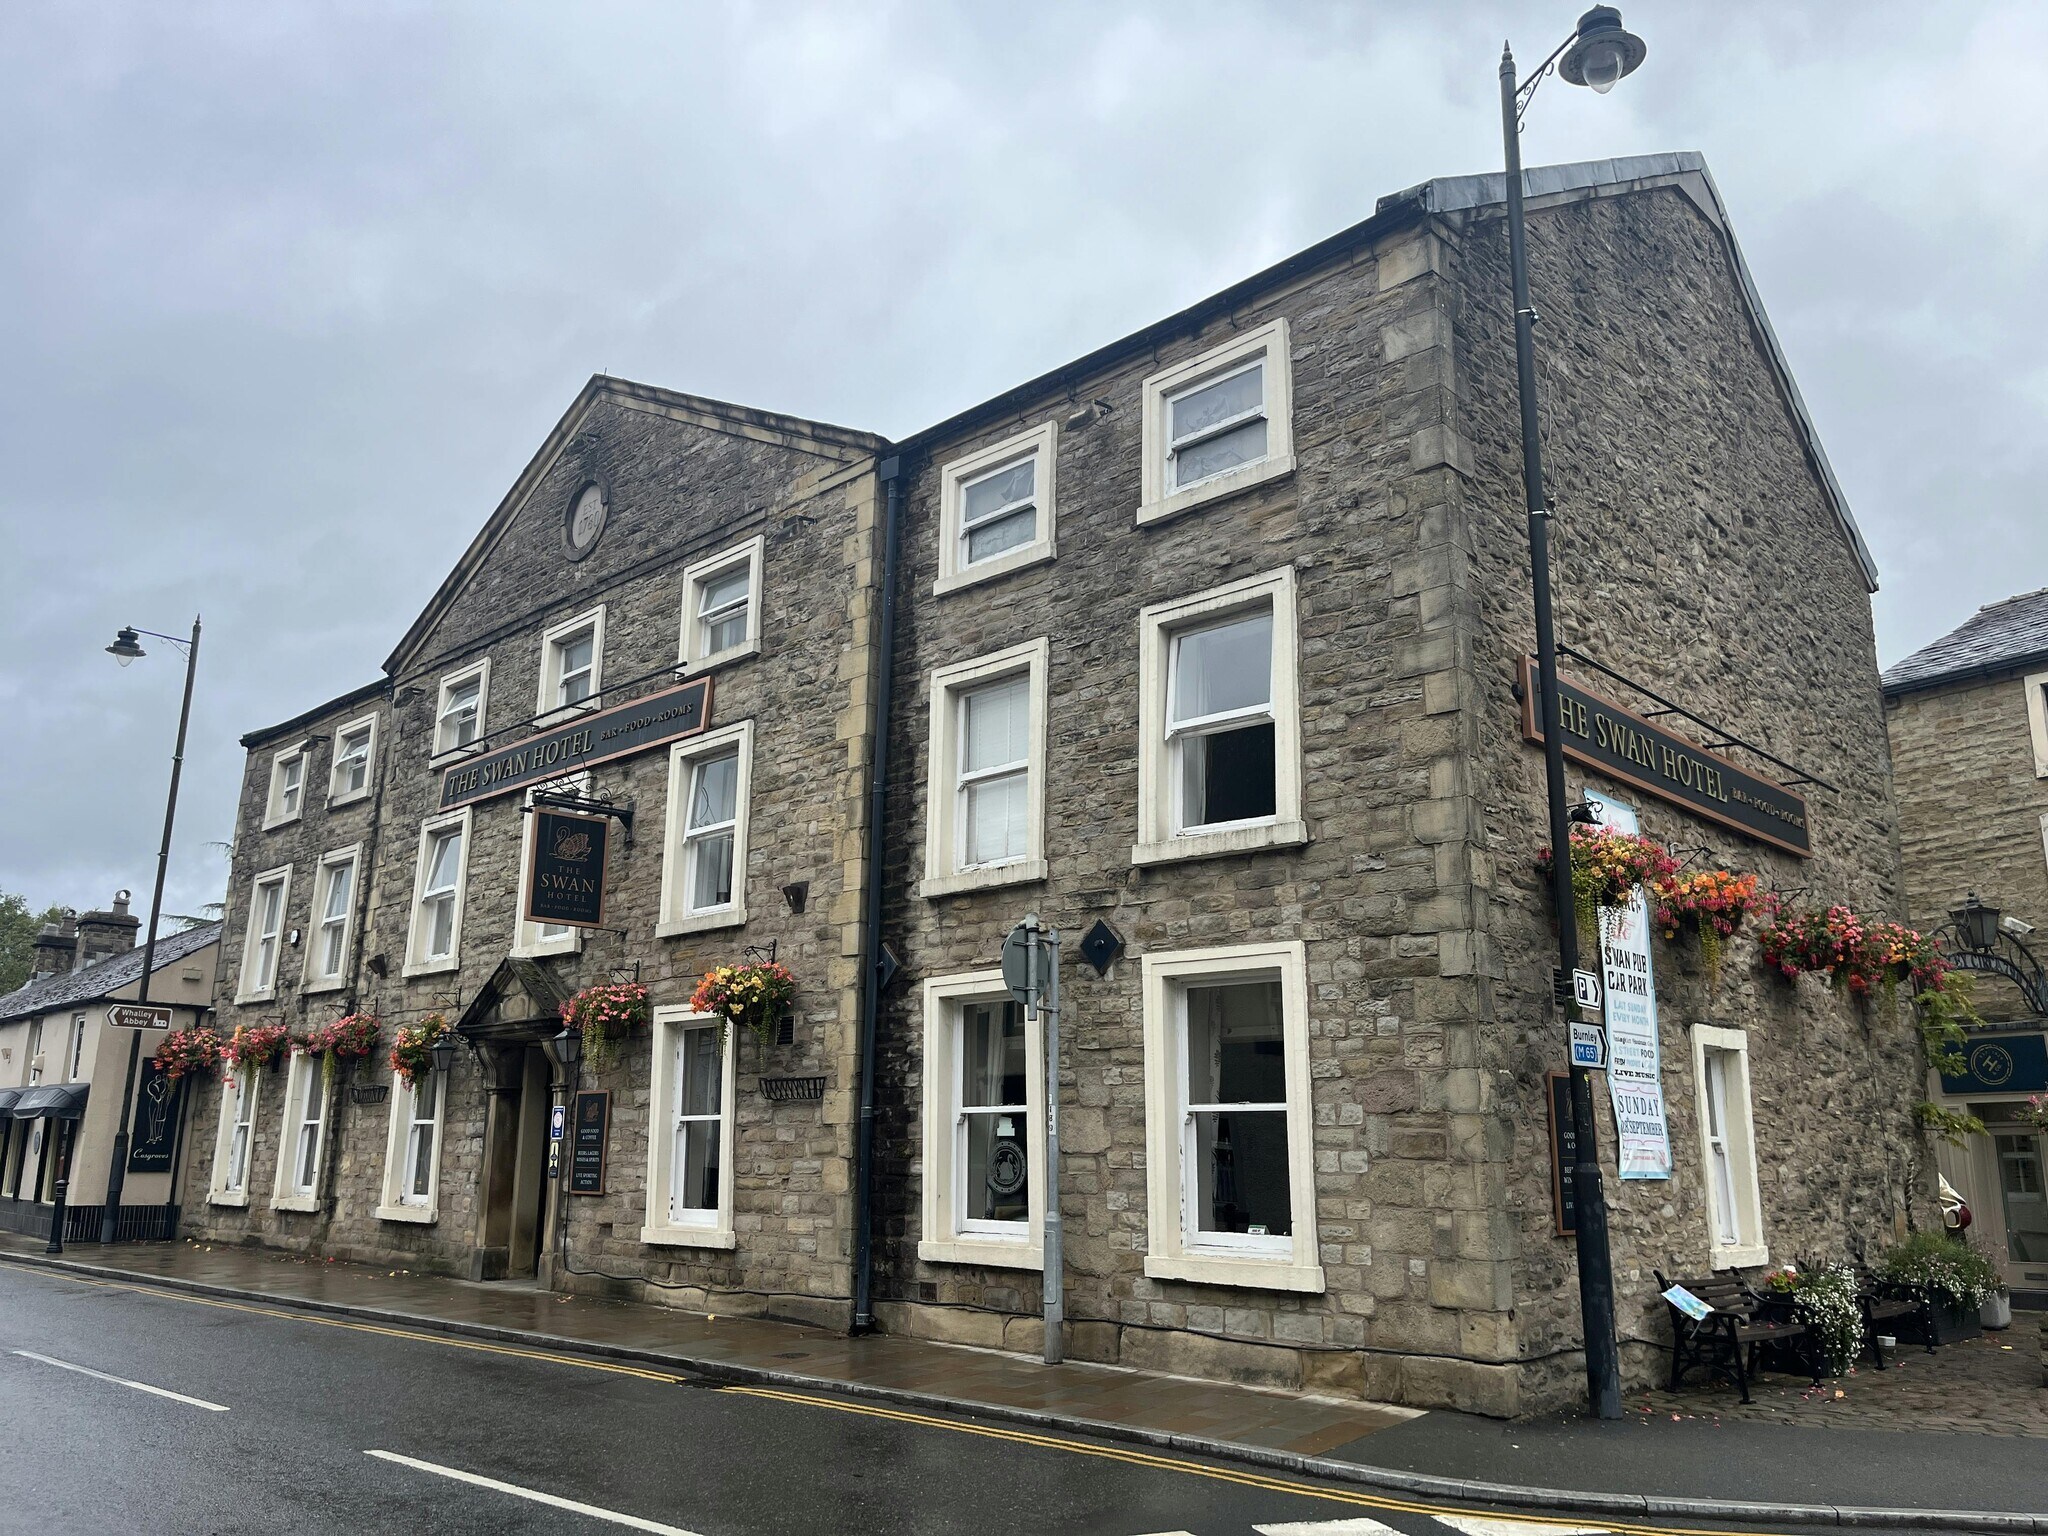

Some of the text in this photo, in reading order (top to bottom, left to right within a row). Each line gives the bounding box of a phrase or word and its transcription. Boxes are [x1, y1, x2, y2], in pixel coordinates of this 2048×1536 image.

[578, 510, 600, 536] 1780
[449, 703, 693, 797] THE SWAN HOTEL BAR FOOD ROOMS
[1595, 712, 1656, 771] SWAN
[1659, 744, 1728, 803] HOTEL
[558, 865, 581, 875] THE
[540, 872, 595, 893] SWAN
[547, 891, 587, 903] HOTEL
[1605, 946, 1647, 973] SWAN PUB
[1579, 978, 1586, 998] P
[1608, 970, 1648, 997] CAR PARK
[121, 1008, 153, 1019] Whalley
[1627, 1002, 1647, 1014] SUNDAY
[123, 1017, 149, 1027] Abbey
[1573, 1028, 1598, 1045] Burnley
[1614, 1068, 1656, 1080] LIVE MUSIC
[1618, 1094, 1660, 1117] SUNDAY
[1630, 1120, 1664, 1137] SEPTEMBER
